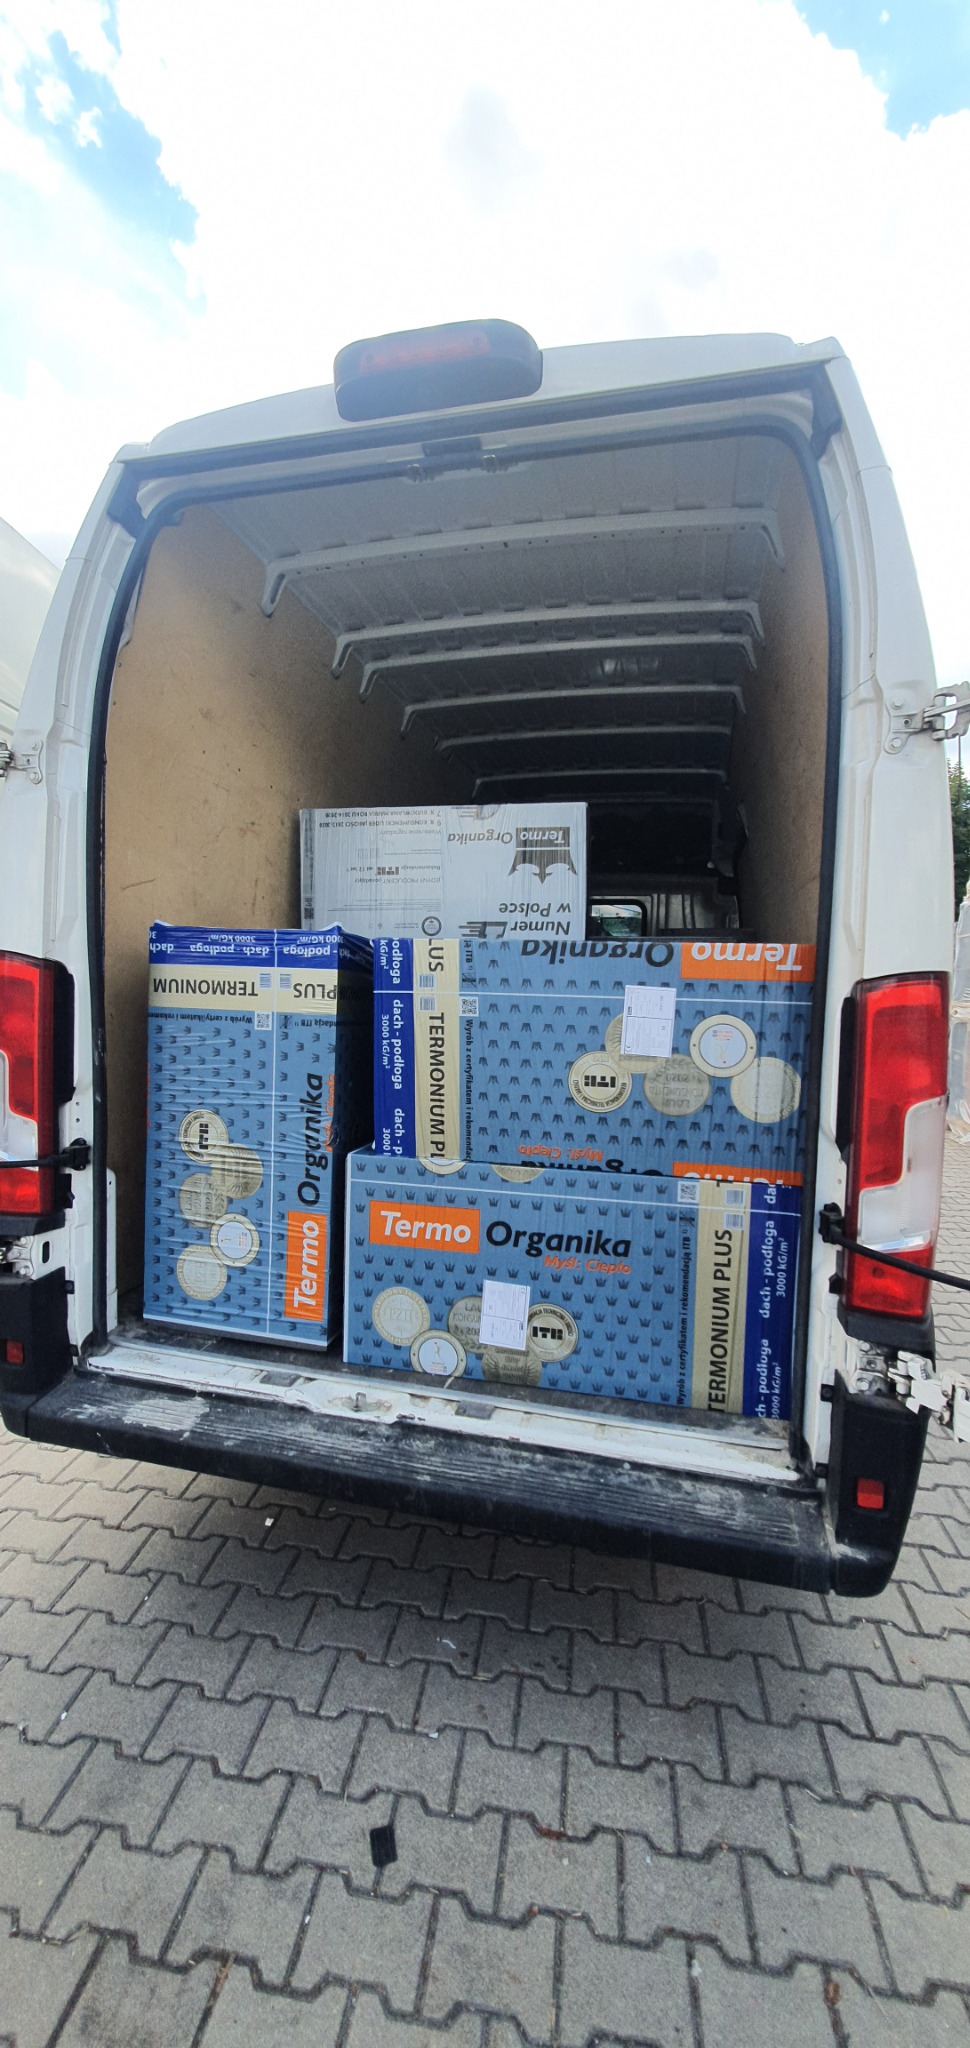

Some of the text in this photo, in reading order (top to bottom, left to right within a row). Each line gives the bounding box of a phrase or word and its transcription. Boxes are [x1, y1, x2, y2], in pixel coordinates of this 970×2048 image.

[447, 829, 565, 845] Termo Organika
[498, 902, 571, 918] w Polsce
[236, 935, 256, 943] 3000
[510, 920, 571, 936] Numer
[150, 942, 174, 954] dach
[190, 942, 235, 956] podłoga
[243, 945, 270, 956] dach
[282, 944, 331, 958] podłoga
[465, 950, 473, 963] ITB
[521, 939, 803, 971] Termo Organika
[153, 978, 259, 997] TERMONIUM
[293, 982, 338, 1000] PLUS
[229, 1015, 253, 1024] Wyrób
[300, 1019, 312, 1027] ITB
[381, 1014, 390, 1038] 3000
[393, 999, 404, 1029] dach
[463, 1019, 474, 1046] Wyrób
[391, 1039, 405, 1090] podłoga
[429, 1012, 445, 1135] TERMONIUM
[463, 1053, 474, 1105] certyfikatem
[584, 1075, 616, 1088] ITB
[394, 1108, 405, 1137] dach
[382, 1127, 391, 1151] 3000
[518, 1143, 562, 1159] Ciepło
[293, 1072, 329, 1308] Termo Organika
[380, 1210, 632, 1258] Termo Organika
[682, 1236, 691, 1250] ITB
[761, 1220, 777, 1276] podłoga
[585, 1258, 632, 1275] Ciepło
[679, 1252, 692, 1311] rekomendacją
[775, 1271, 787, 1298] 3000
[758, 1286, 772, 1319] dach
[532, 1325, 564, 1341] ITB
[708, 1229, 733, 1413] TERMONIUM PLUS
[677, 1317, 688, 1370] certyfikatem
[756, 1339, 772, 1394] podłoga
[676, 1378, 687, 1405] Wyrób
